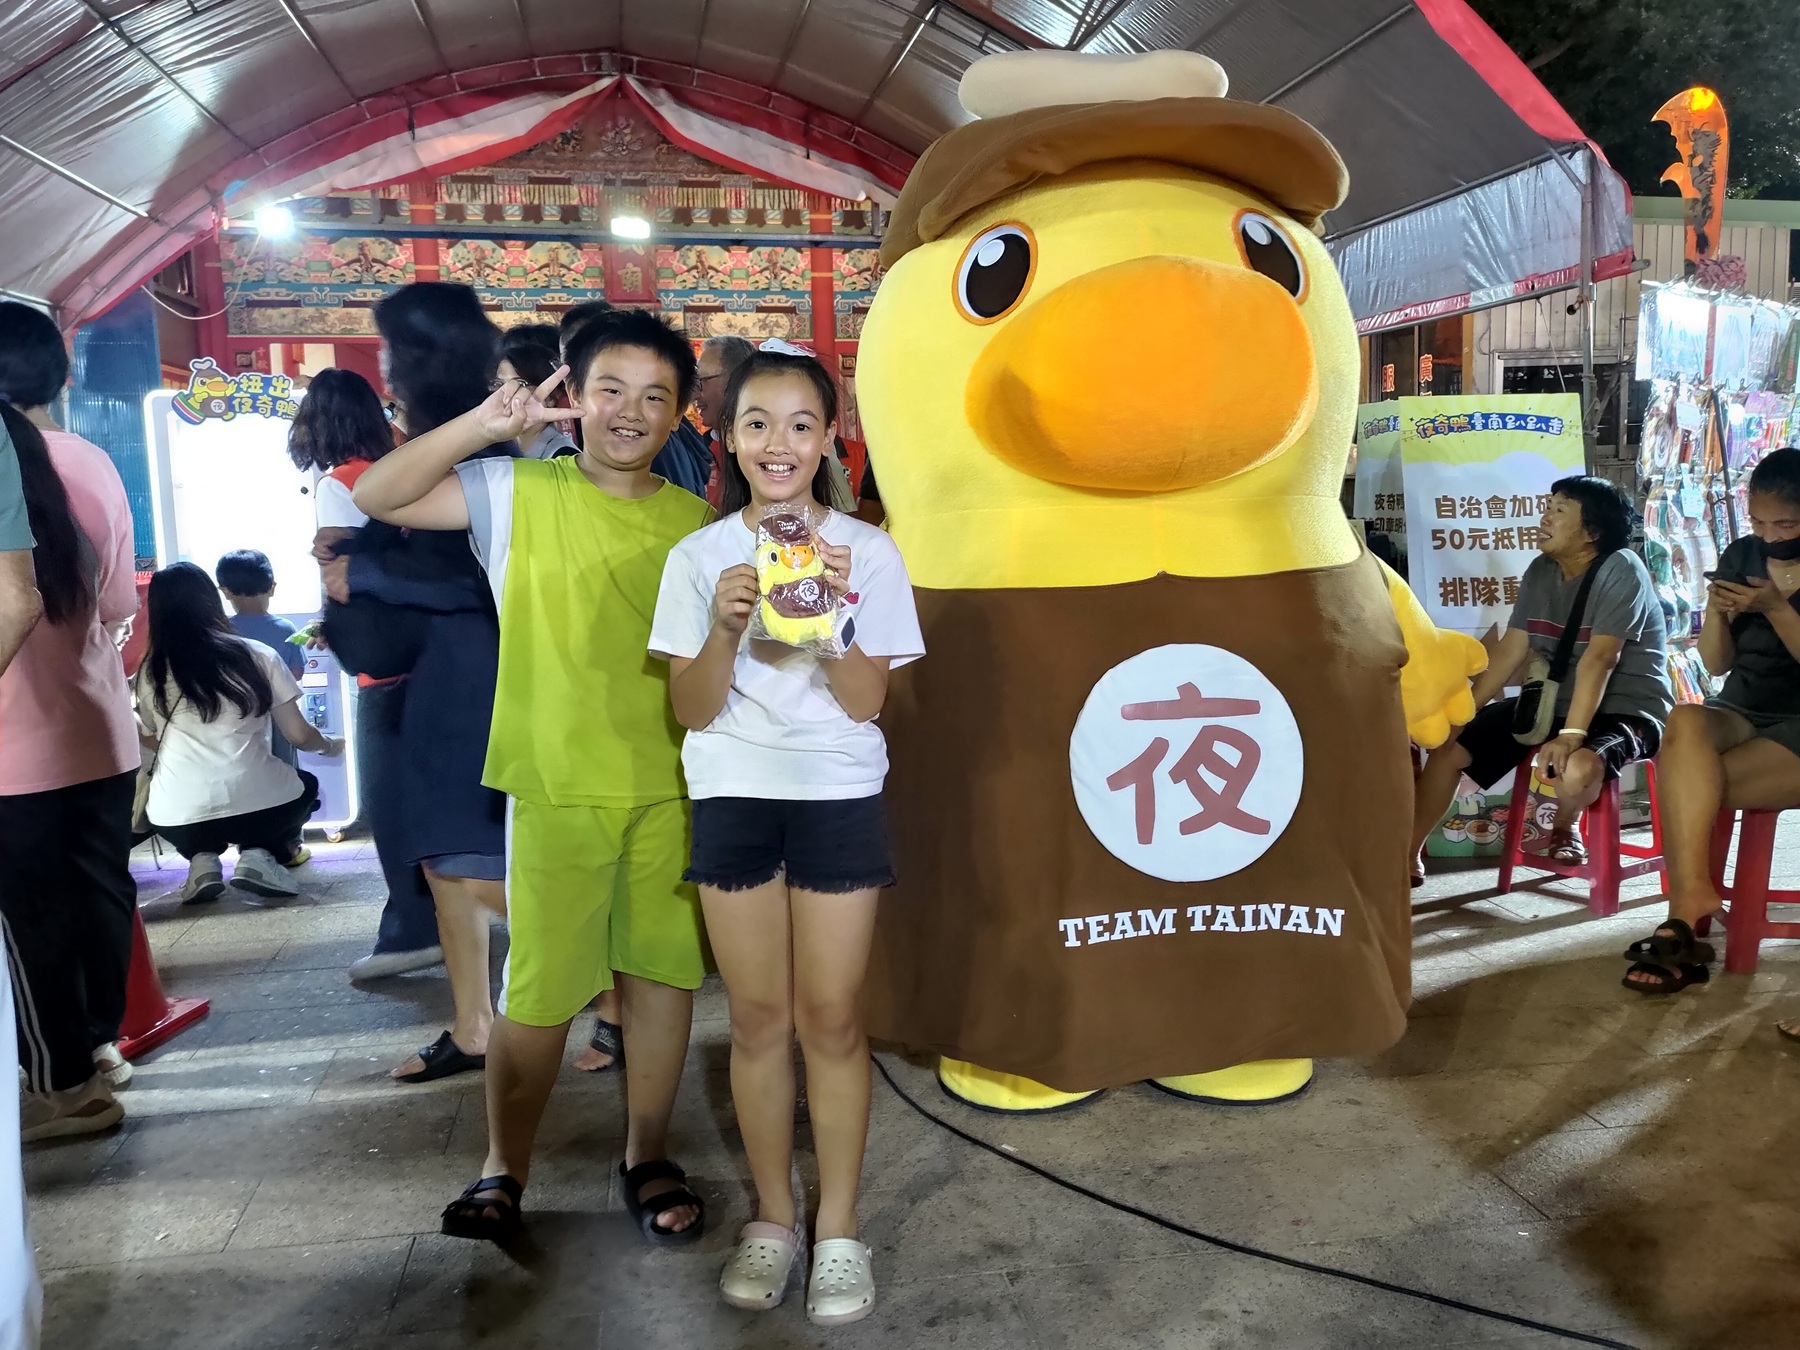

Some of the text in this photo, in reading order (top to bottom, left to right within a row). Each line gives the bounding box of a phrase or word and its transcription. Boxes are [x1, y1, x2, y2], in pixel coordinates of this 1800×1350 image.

[240, 375, 290, 398] 扭出
[1382, 364, 1395, 401] 服
[232, 391, 299, 418] 夜奇鴨
[801, 580, 818, 598] 夜
[1106, 681, 1271, 845] 夜
[1058, 903, 1345, 947] TEAM TAINAN
